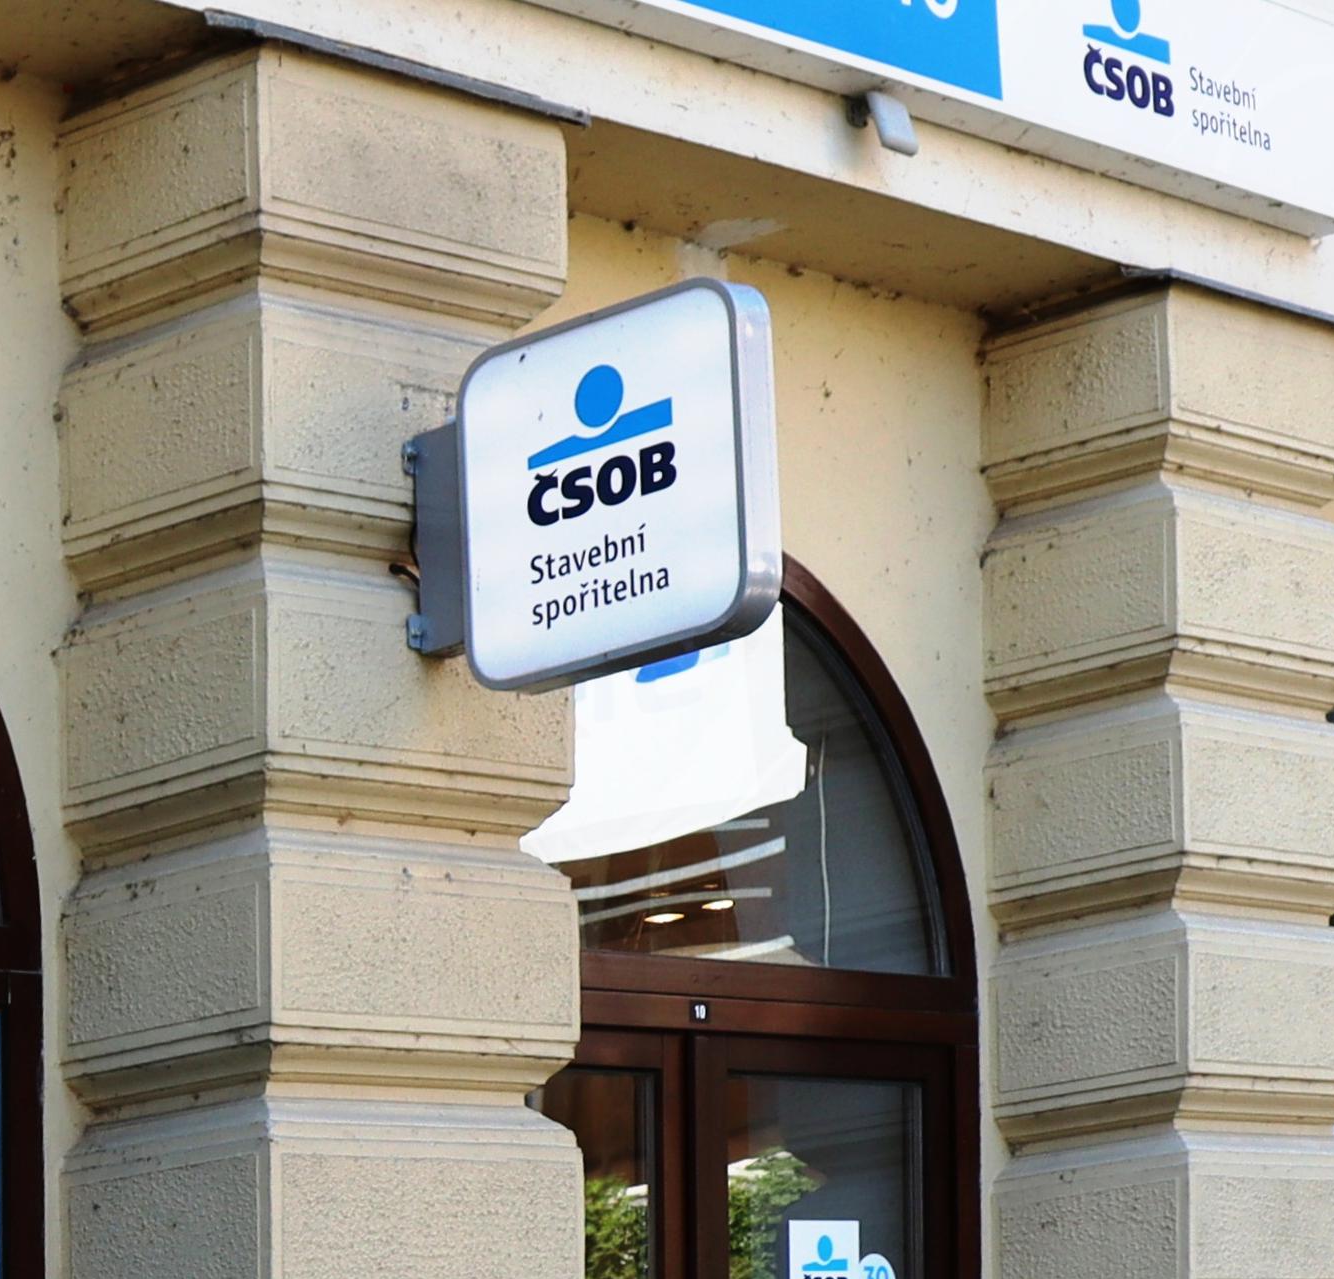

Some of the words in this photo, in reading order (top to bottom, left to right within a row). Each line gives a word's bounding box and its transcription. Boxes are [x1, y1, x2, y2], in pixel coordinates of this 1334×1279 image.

[1083, 43, 1175, 118] ČSOB
[1189, 66, 1257, 111] Stavební
[1192, 108, 1272, 151] spořitelna
[527, 441, 677, 527] ČSOB
[529, 523, 647, 584] Stavební
[531, 565, 670, 630] spořitelna
